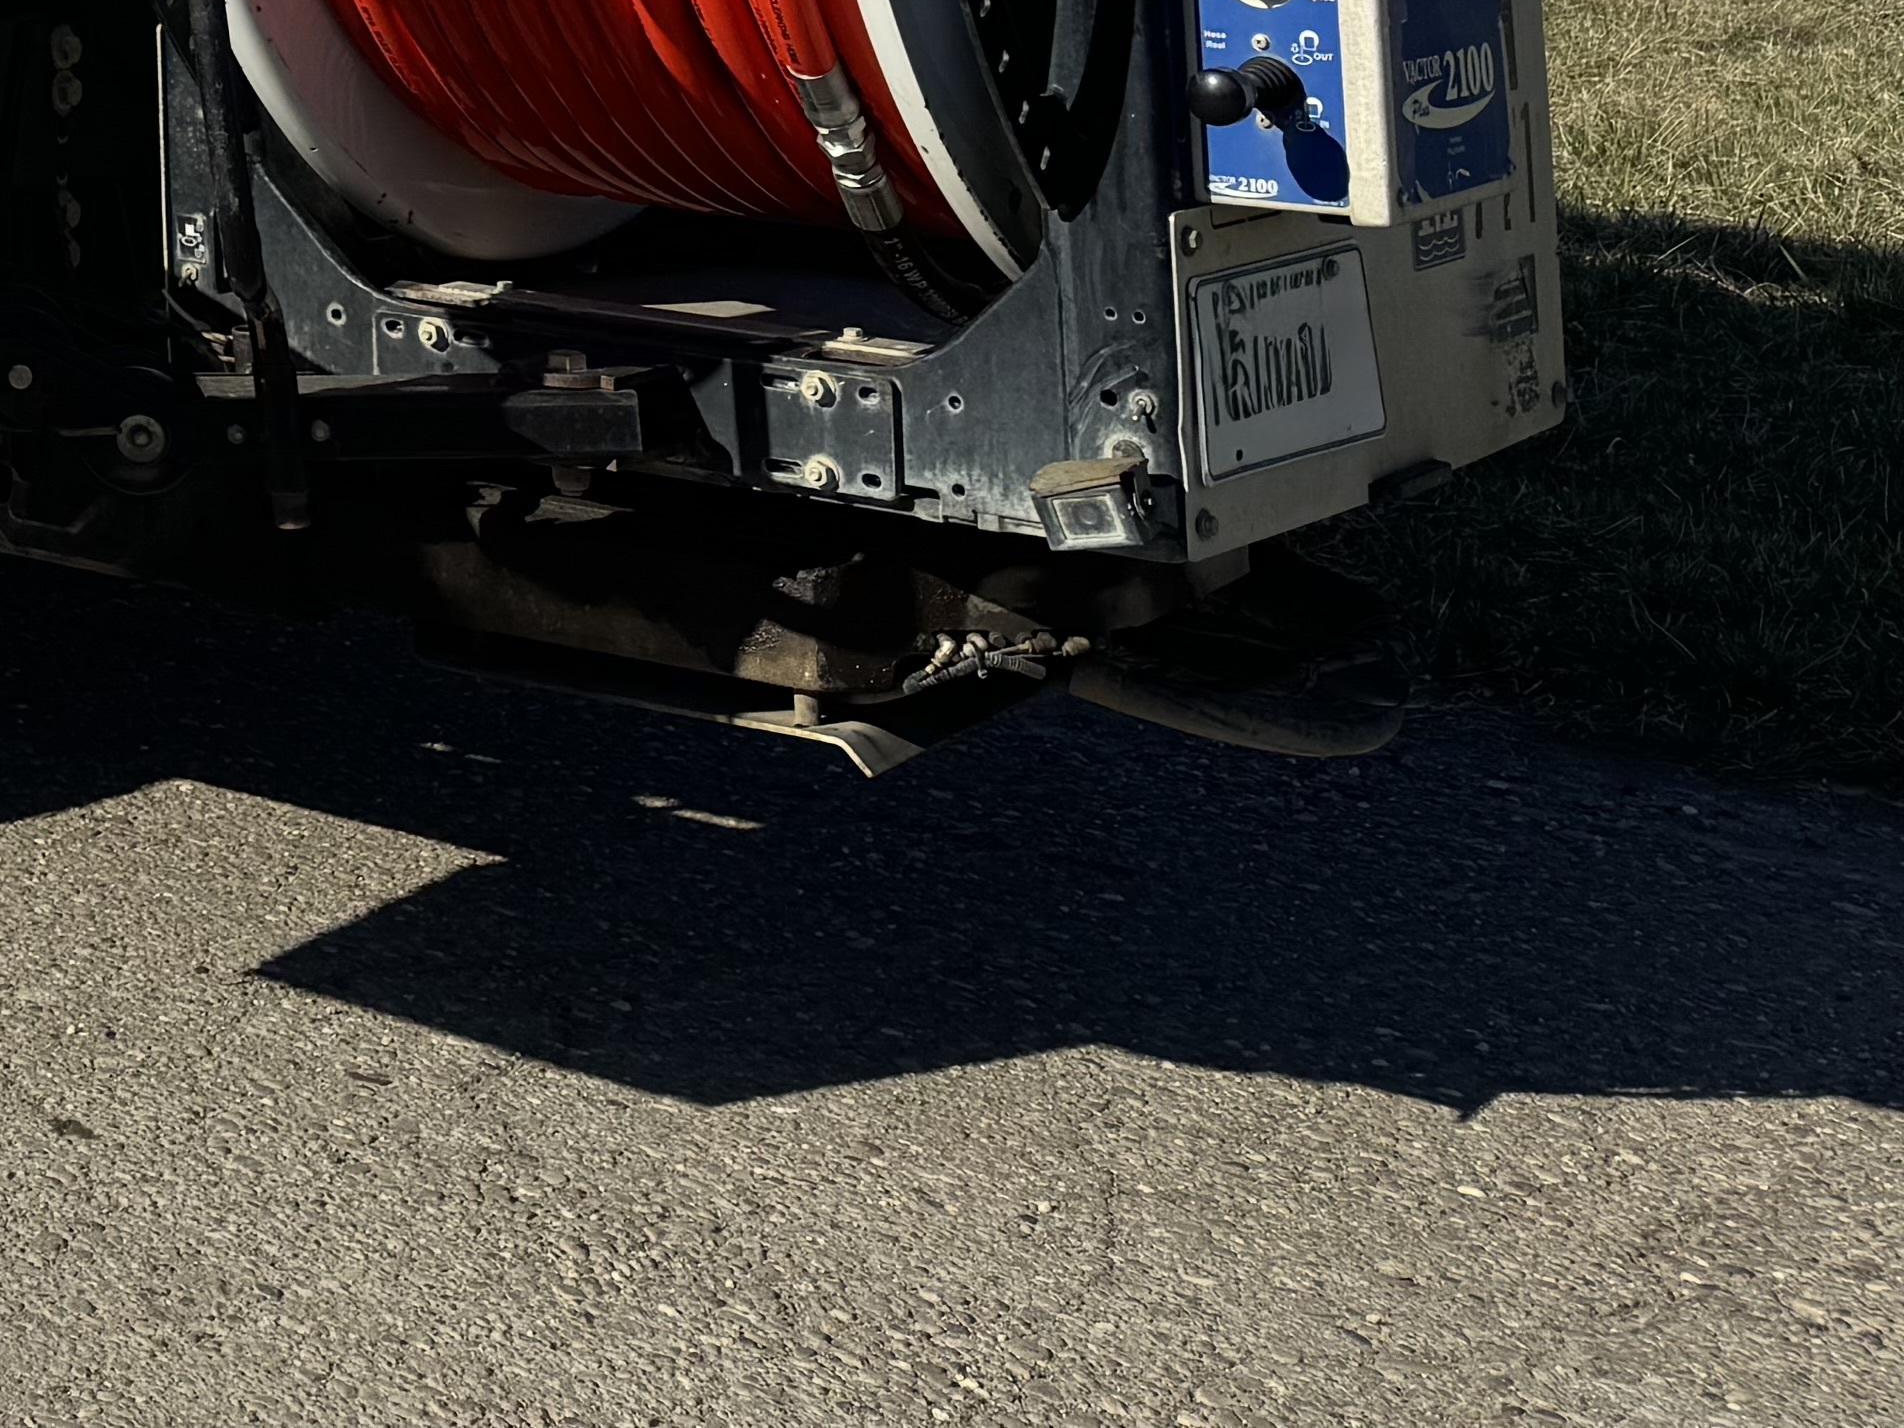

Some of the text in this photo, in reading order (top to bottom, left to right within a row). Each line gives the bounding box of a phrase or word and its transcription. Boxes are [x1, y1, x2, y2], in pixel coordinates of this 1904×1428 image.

[1204, 30, 1227, 40] Hose
[1205, 40, 1226, 50] Reel
[1313, 52, 1333, 62] OUT
[1403, 42, 1495, 101] VACTOR 2100
[1238, 176, 1279, 194] 2100
